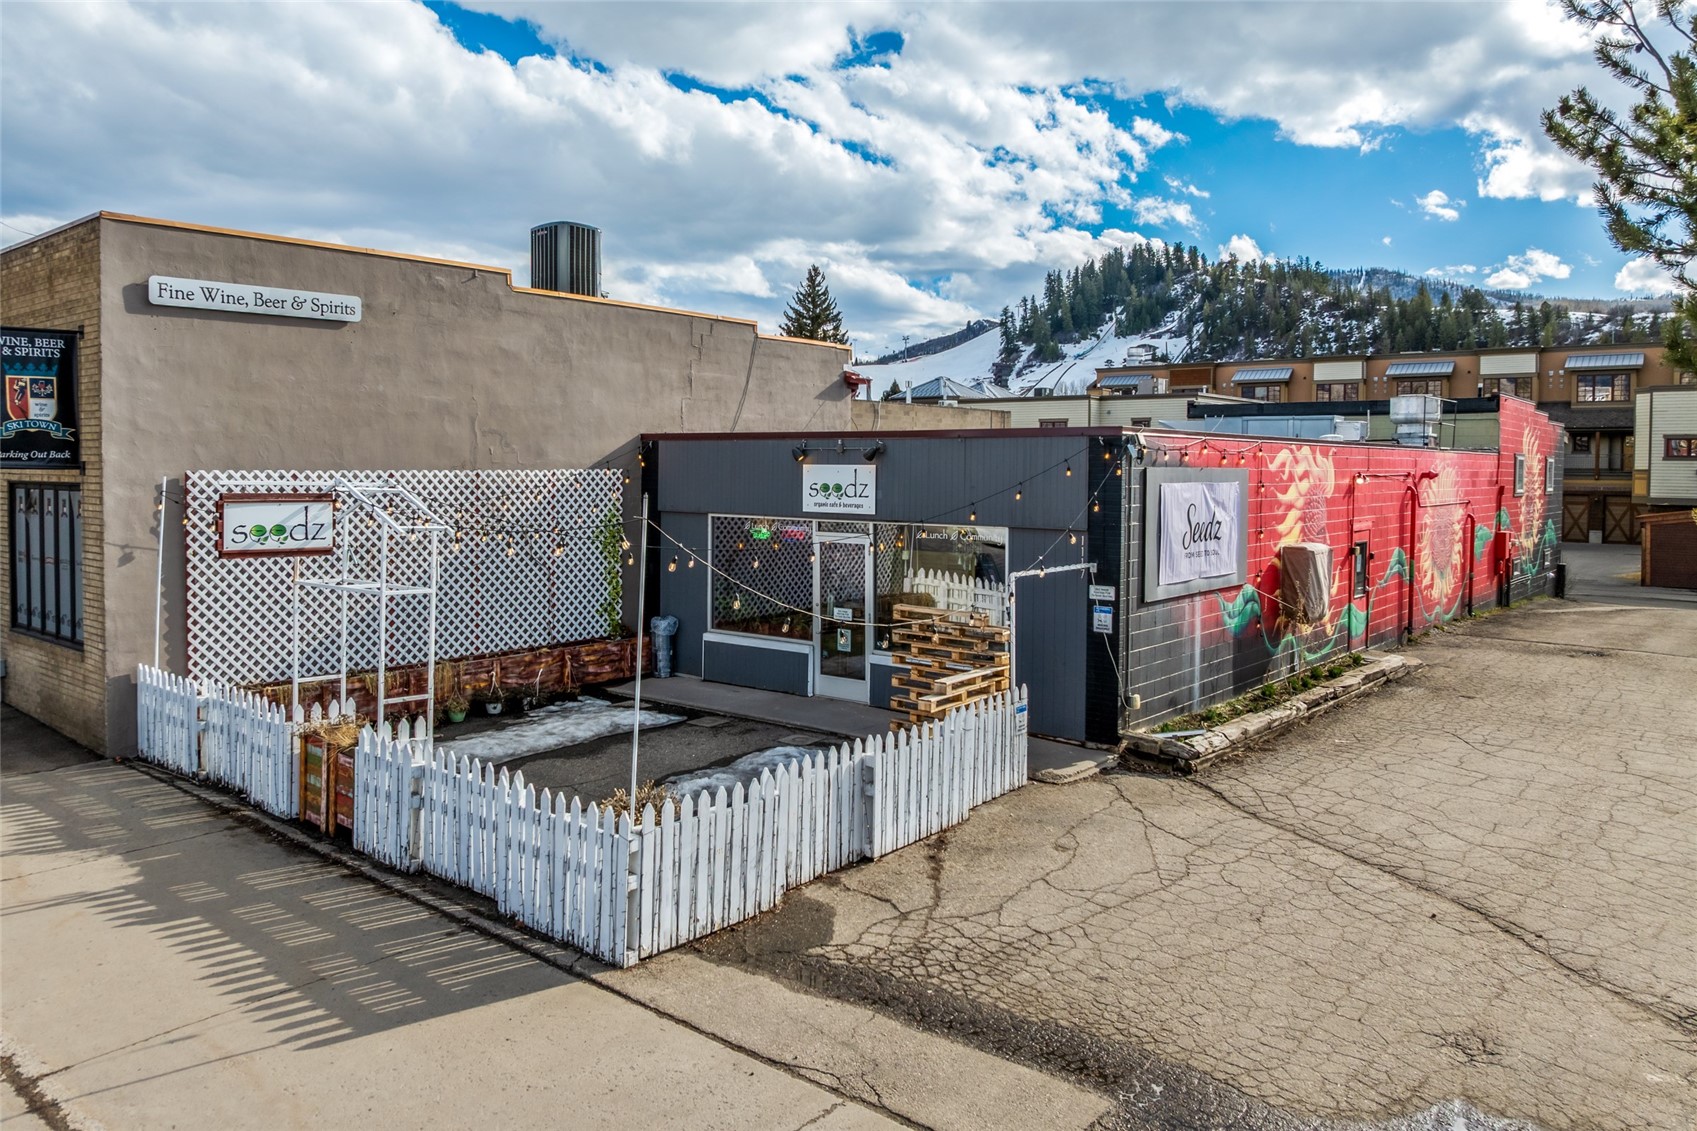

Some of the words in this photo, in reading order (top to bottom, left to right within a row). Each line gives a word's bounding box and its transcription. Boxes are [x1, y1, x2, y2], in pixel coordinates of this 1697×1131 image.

[157, 282, 195, 301] Fine
[199, 286, 249, 308] Wine,
[253, 291, 287, 309] Beer
[291, 295, 306, 310] &
[310, 298, 356, 316] Spirits
[34, 338, 66, 349] BEER
[2, 346, 12, 356] &
[14, 347, 60, 358] SPIRITS
[6, 420, 24, 431] SKI
[24, 420, 57, 431] TOWN
[0, 450, 29, 460] arking
[30, 450, 47, 458] Out
[49, 450, 71, 458] Back
[808, 468, 869, 500] seedz
[231, 505, 327, 546] seedz
[1182, 503, 1223, 550] Seedz
[925, 529, 948, 540] Lunch
